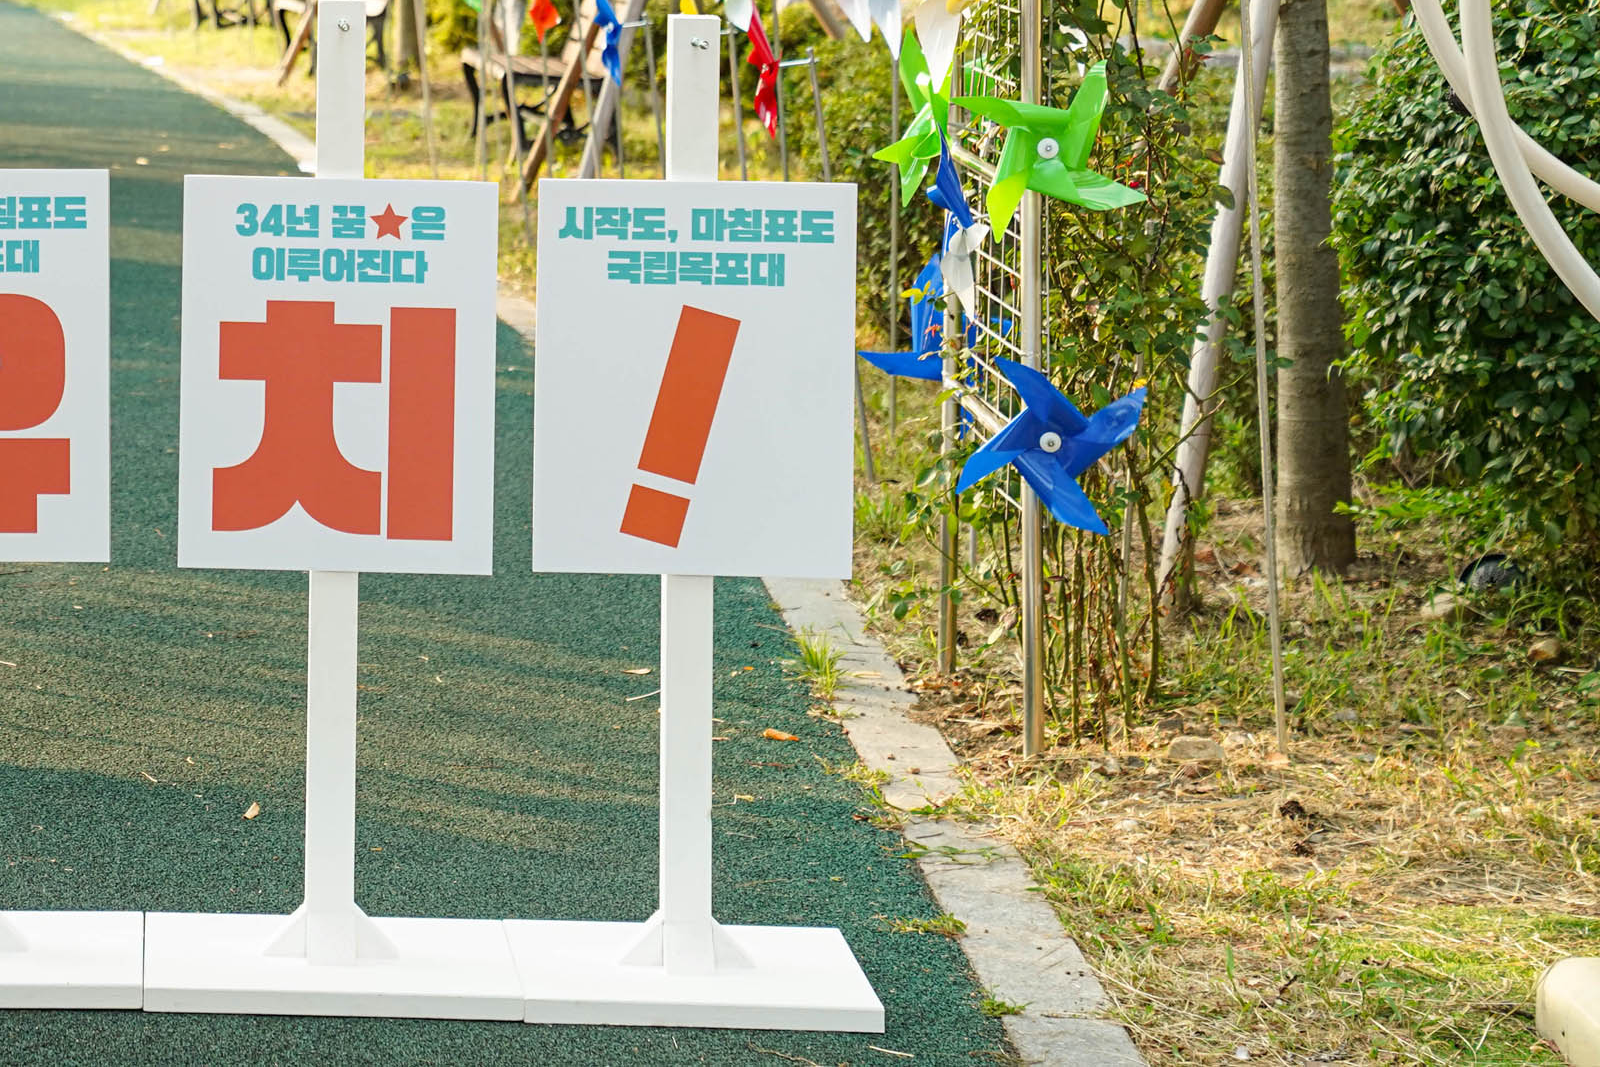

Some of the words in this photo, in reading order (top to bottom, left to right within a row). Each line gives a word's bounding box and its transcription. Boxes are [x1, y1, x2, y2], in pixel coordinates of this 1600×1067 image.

[236, 203, 319, 238] 34년
[559, 206, 678, 243] 시작도,
[692, 208, 834, 243] 마침표도
[252, 247, 428, 284] 이루어진다
[608, 251, 784, 286] 국립목포대
[212, 301, 456, 540] 치
